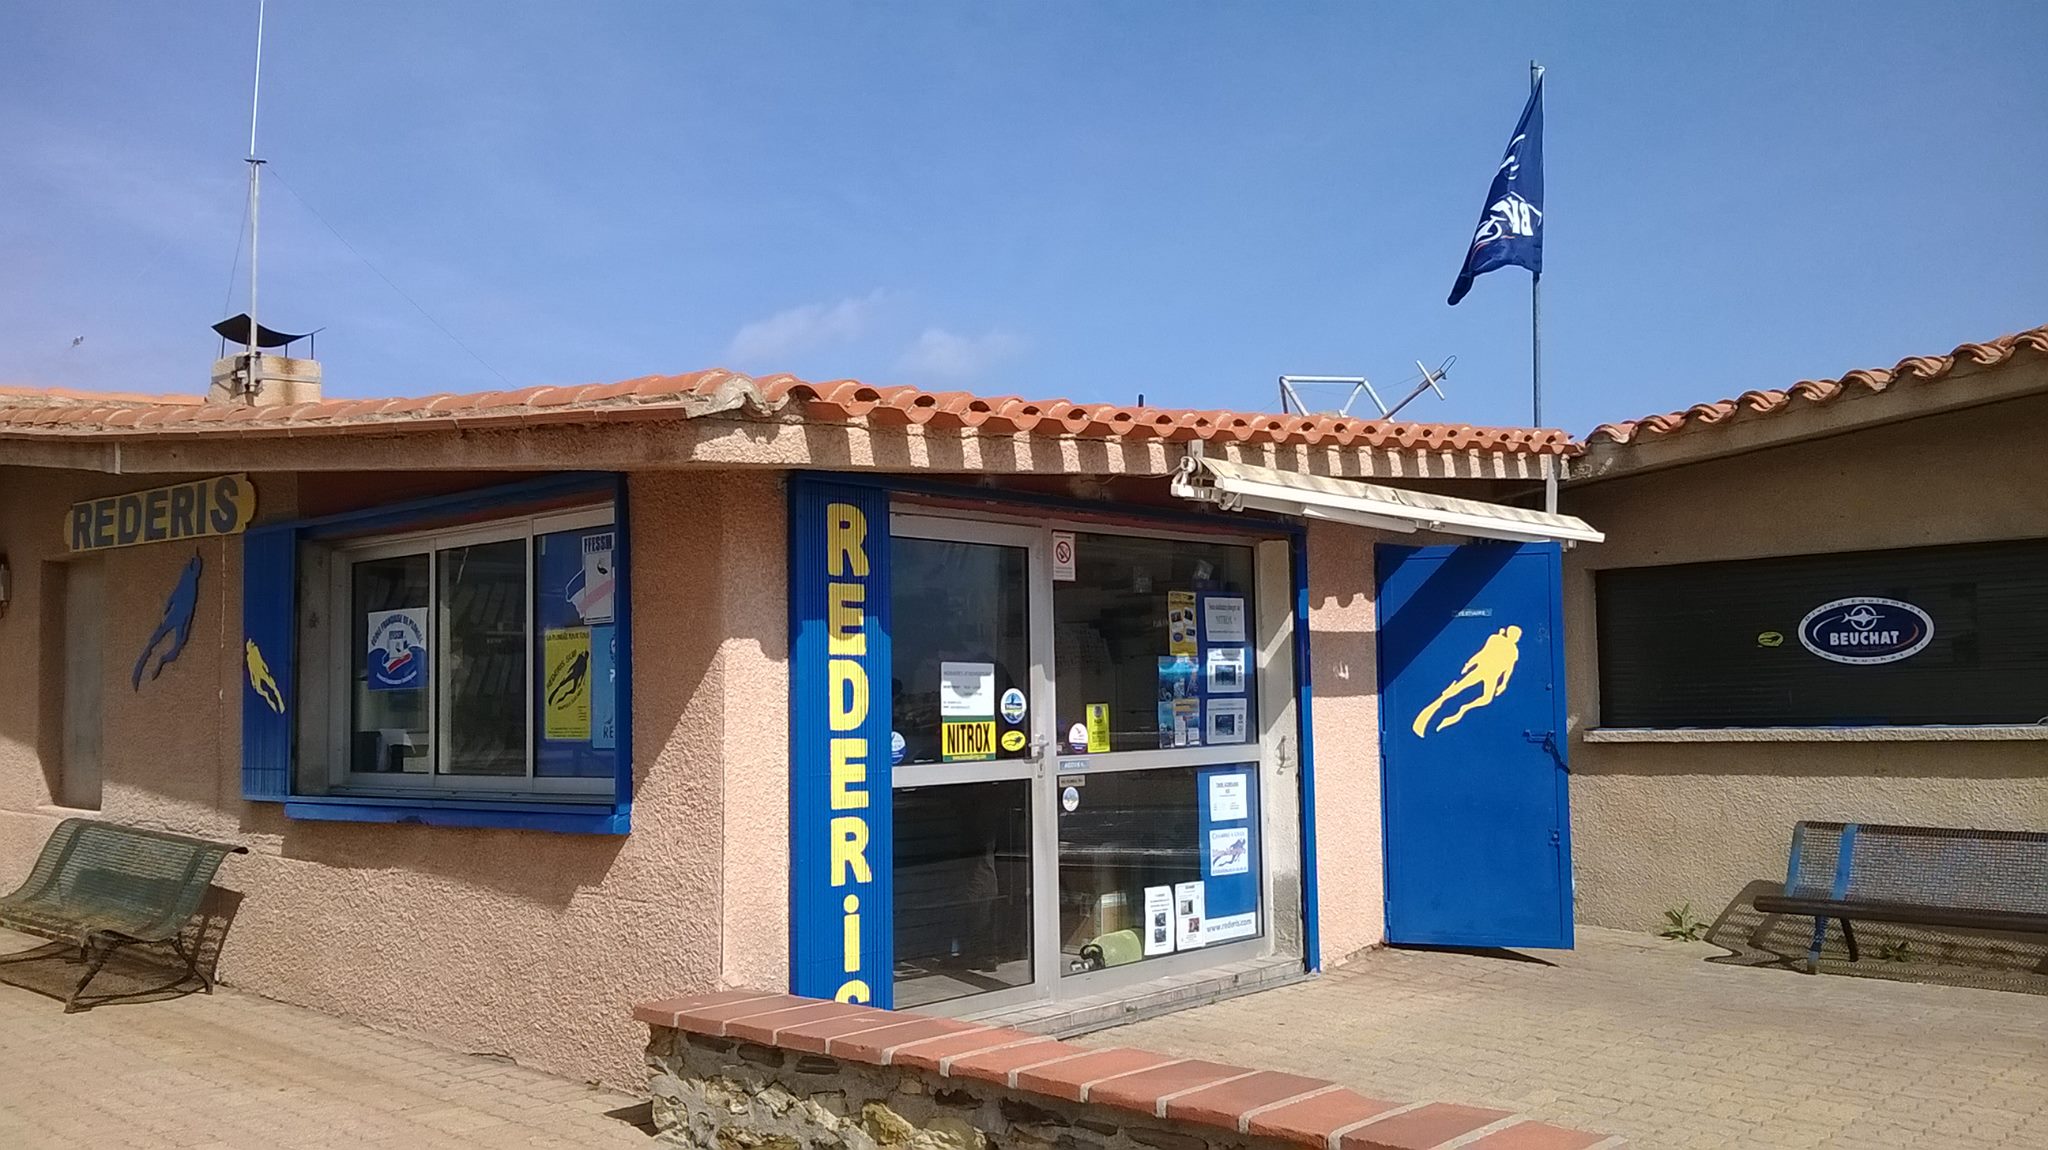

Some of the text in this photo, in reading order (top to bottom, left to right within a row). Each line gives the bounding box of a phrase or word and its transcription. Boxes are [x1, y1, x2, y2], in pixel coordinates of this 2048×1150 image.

[72, 477, 239, 549] REDERIS
[1829, 631, 1900, 646] BEUCHAT
[947, 723, 991, 754] NITROX
